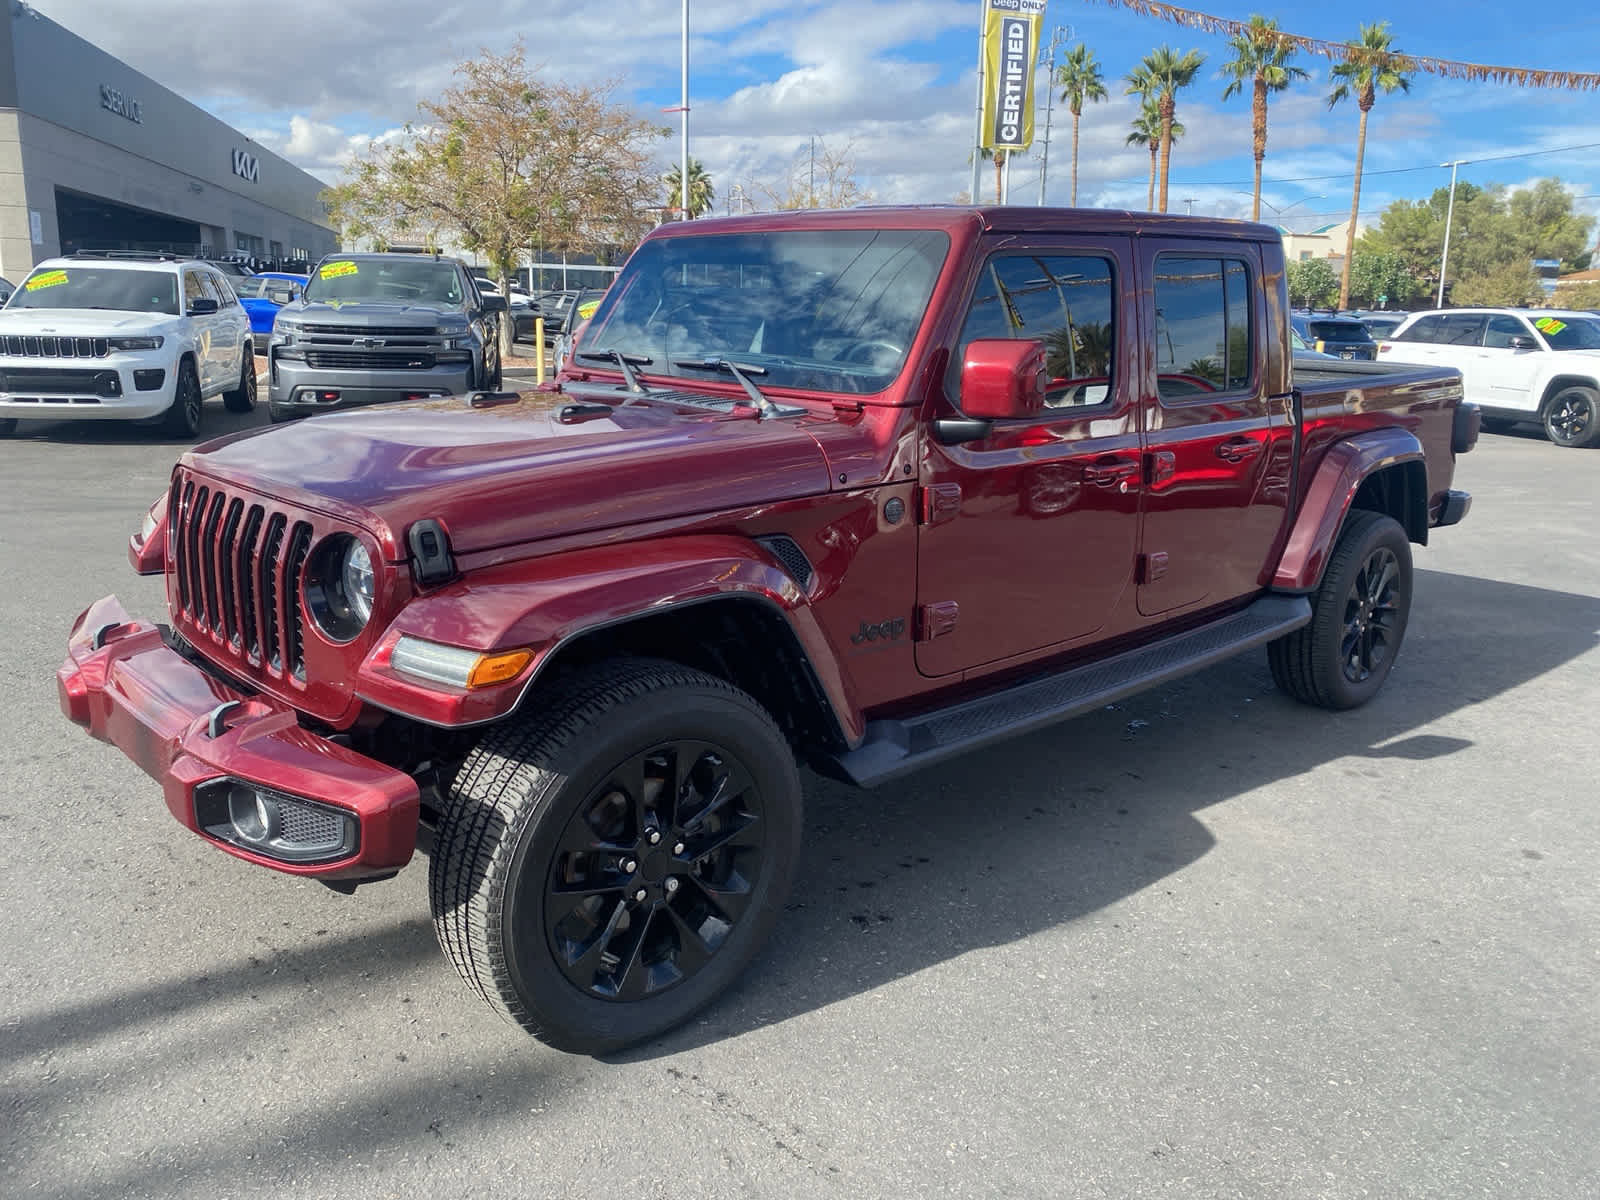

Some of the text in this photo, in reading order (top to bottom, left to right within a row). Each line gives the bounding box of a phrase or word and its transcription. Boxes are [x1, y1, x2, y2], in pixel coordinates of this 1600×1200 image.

[1022, 1, 1044, 9] ONLY
[1001, 22, 1024, 141] CERTIFIED
[102, 85, 143, 124] SERVICE
[850, 618, 904, 645] Jeep
